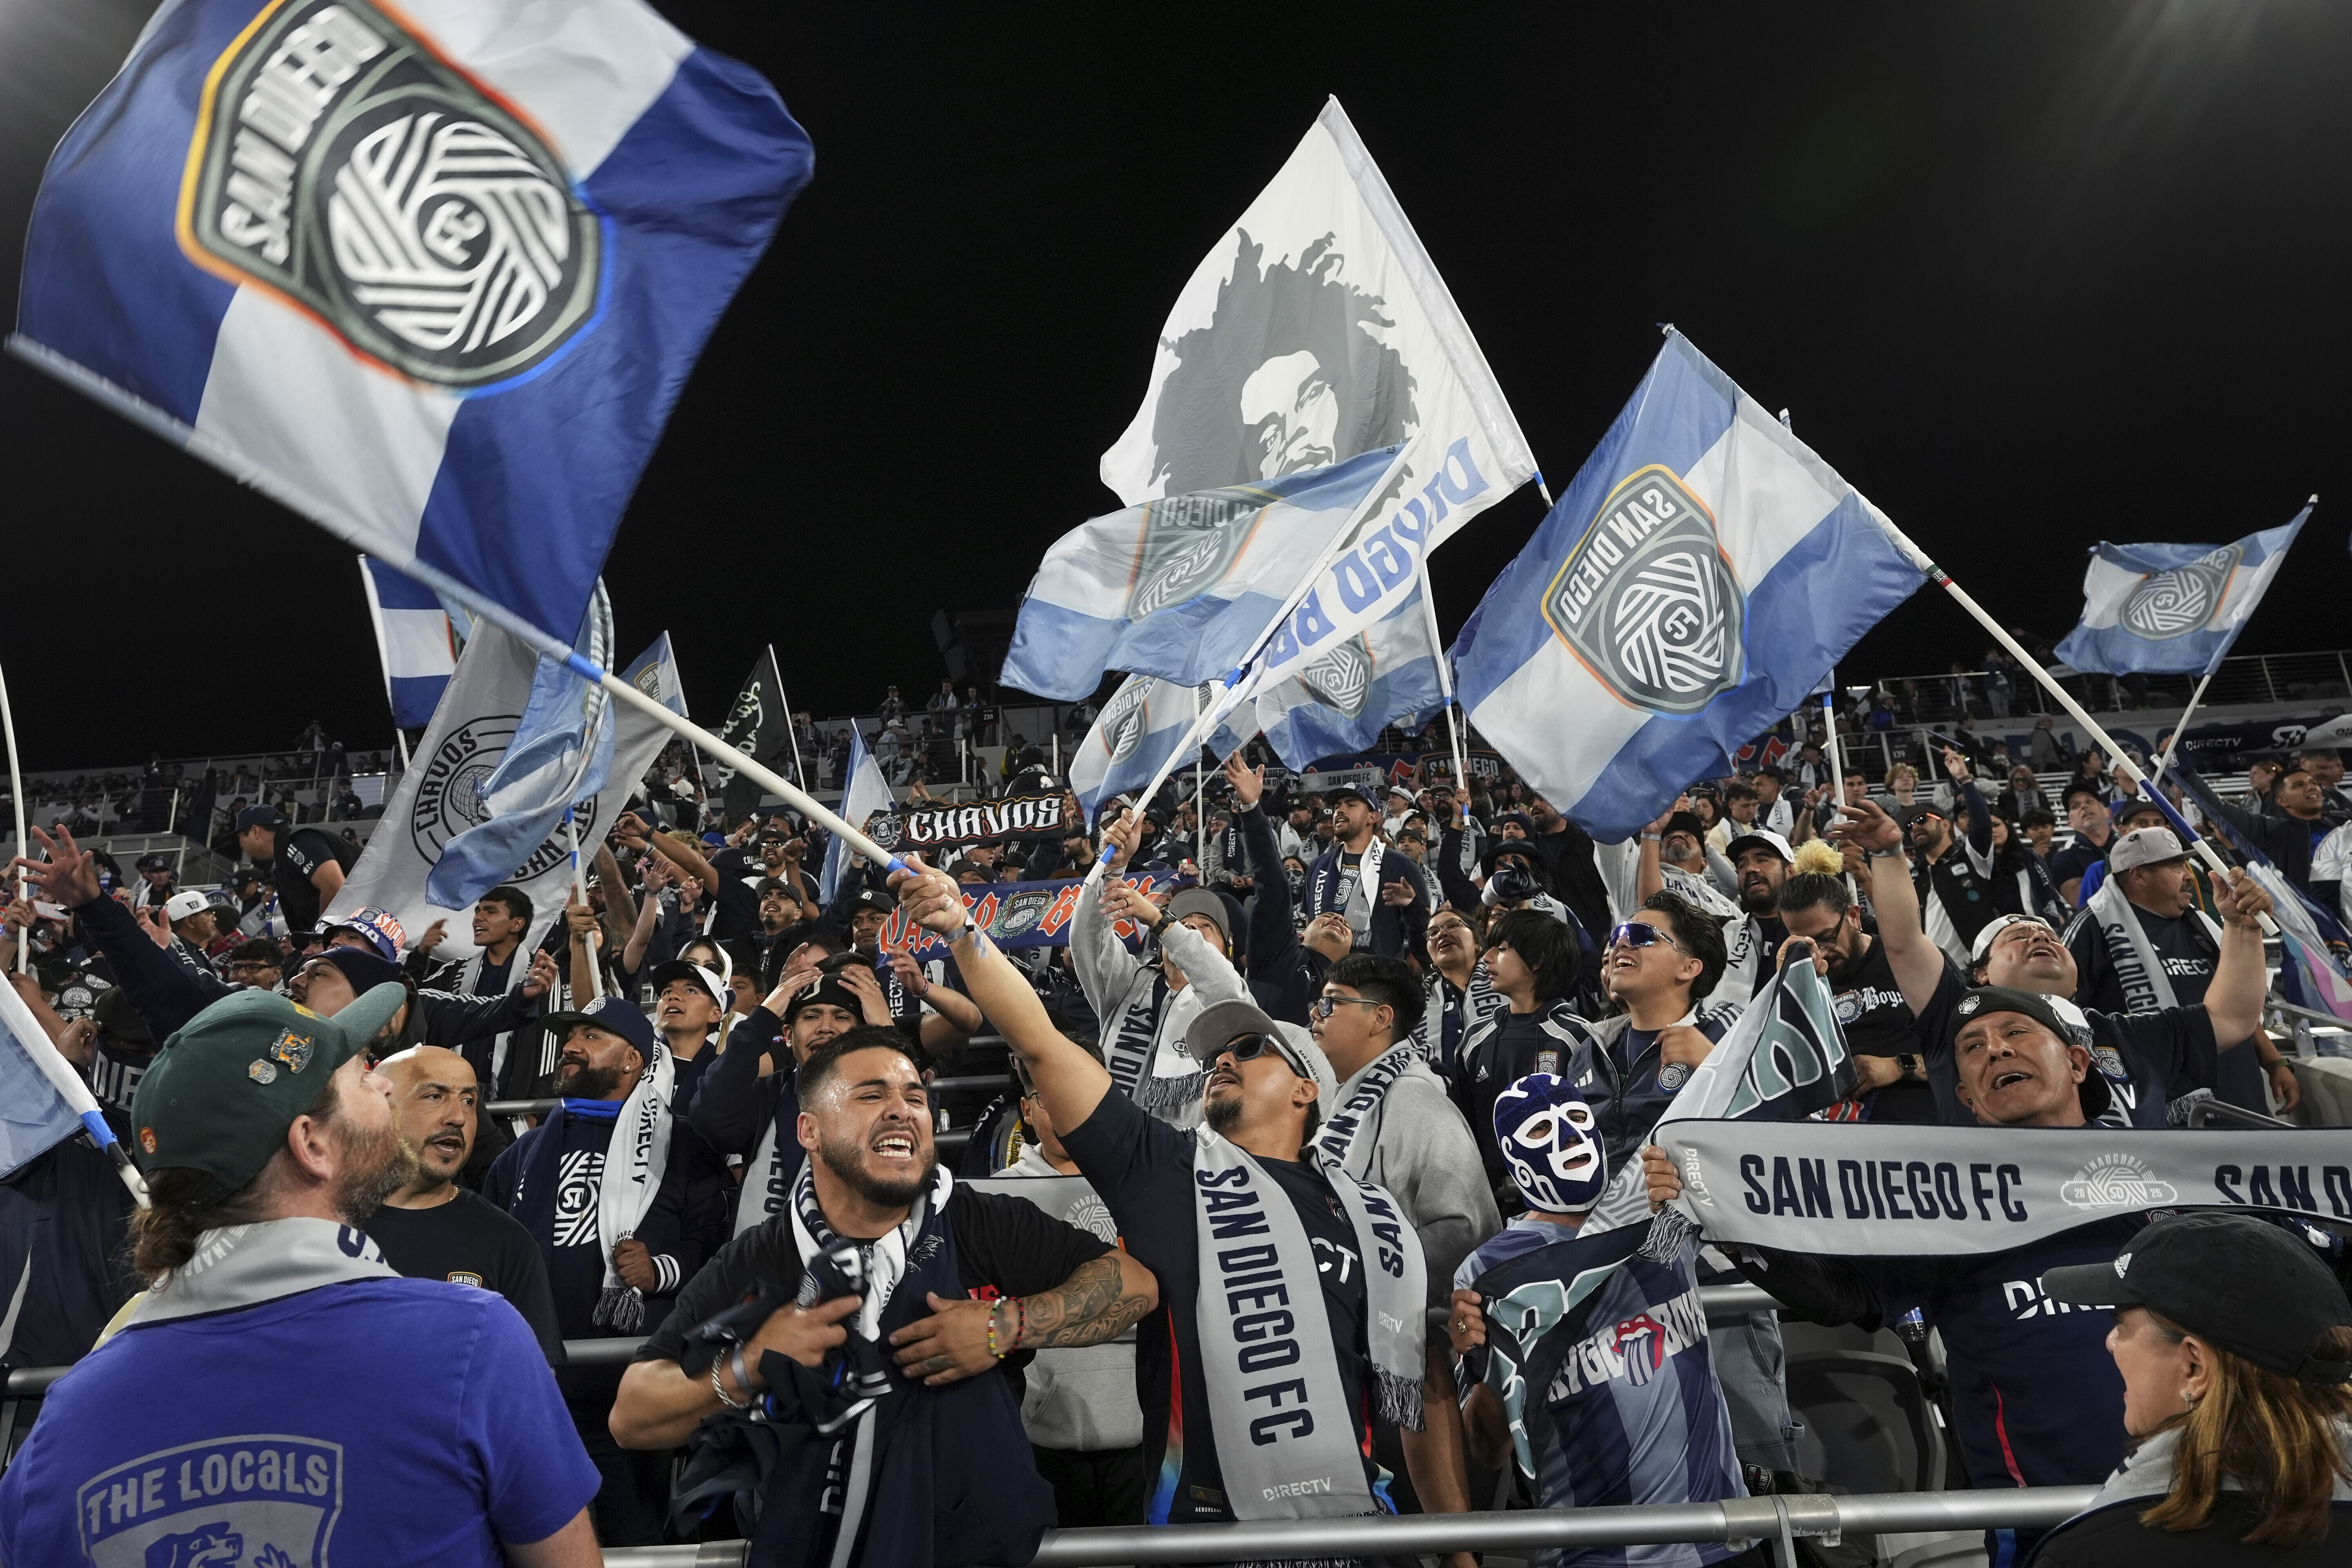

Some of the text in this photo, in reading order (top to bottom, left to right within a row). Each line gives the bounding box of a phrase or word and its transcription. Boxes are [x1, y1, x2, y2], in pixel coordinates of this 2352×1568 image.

[221, 3, 388, 265] SAN DIEGO
[2185, 737, 2241, 751] DIRECTV
[1328, 772, 1370, 786] SAN DIEGO FC
[909, 797, 1062, 842] CHAVOS
[1227, 828, 1236, 857] DIRECTV
[1014, 897, 1046, 909] SAN DIEGO
[375, 913, 397, 939] SAN
[2105, 923, 2138, 964] SAN
[1959, 996, 1979, 1009] LMB
[1114, 1003, 1154, 1056] SAN
[1298, 1050, 1307, 1060] SAN
[1306, 1060, 1316, 1076] DIEGO
[1475, 1073, 1489, 1083] adidas
[2083, 1153, 2147, 1173] INAUGURAL
[1683, 1148, 1714, 1208] DIRECTV
[1740, 1154, 2028, 1222] SAN DIEGO FC
[2215, 1164, 2319, 1212] SAN
[2074, 1188, 2085, 1199] 20
[2109, 1187, 2125, 1199] SD
[2149, 1187, 2163, 1198] 25
[1360, 1191, 1404, 1278] SAN
[451, 1275, 479, 1286] SAN DIEGO
[1196, 1165, 1314, 1446] SAN DIEGO FC
[1379, 1310, 1403, 1334] DIRECTV
[86, 1467, 166, 1535] THE
[1262, 1477, 1331, 1502] DIRECTV
